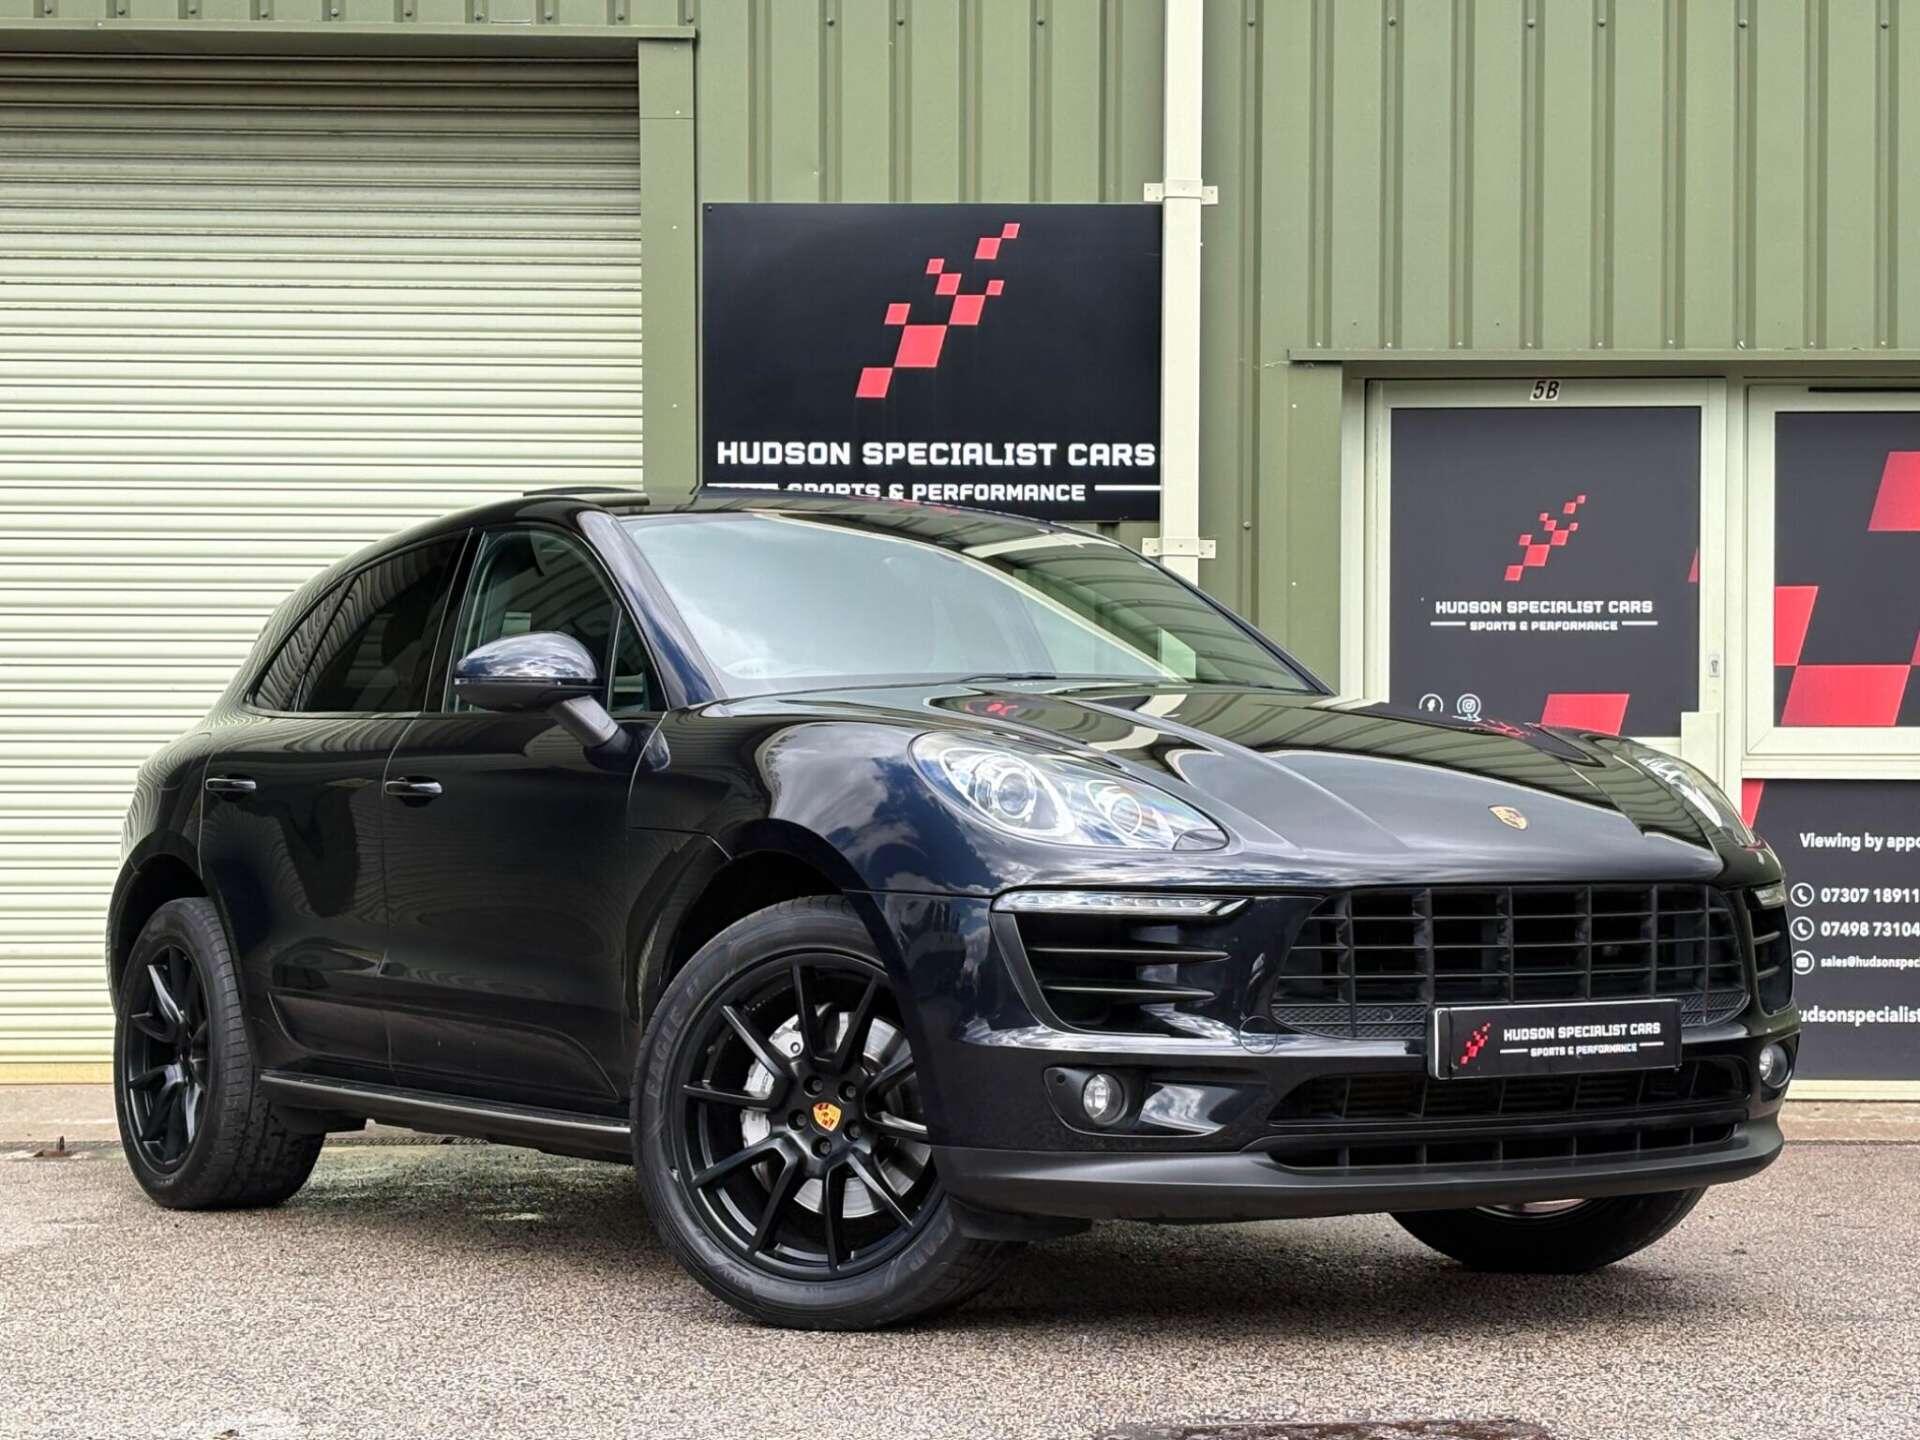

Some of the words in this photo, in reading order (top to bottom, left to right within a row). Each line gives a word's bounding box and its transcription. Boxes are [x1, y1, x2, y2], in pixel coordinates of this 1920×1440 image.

[1533, 380, 1559, 399] 5B
[717, 441, 851, 465] HUDSON
[862, 442, 1058, 466] SPECIALIST
[1067, 443, 1156, 467] CARS
[888, 483, 905, 500] &
[912, 484, 1086, 502] PERFORMANCE
[1435, 600, 1502, 614] HUDSON
[1506, 600, 1603, 614] SPECIALIST
[1608, 600, 1654, 614] CARS
[1470, 620, 1517, 631] SPORTS
[1531, 620, 1619, 631] PERFORMANCE
[1799, 831, 1862, 852] Viewing
[1864, 831, 1884, 853] by
[1820, 887, 1870, 904] 07307
[1872, 887, 1920, 904] 18911
[1820, 920, 1870, 937] 07498
[1872, 921, 1920, 938] 73104
[1503, 1026, 1555, 1042] HUDSON
[1557, 1023, 1627, 1040] SPECIALIST
[1629, 1021, 1662, 1036] CARS
[1530, 1046, 1566, 1058] SPORTS
[1576, 1042, 1637, 1056] PERFORMANCE
